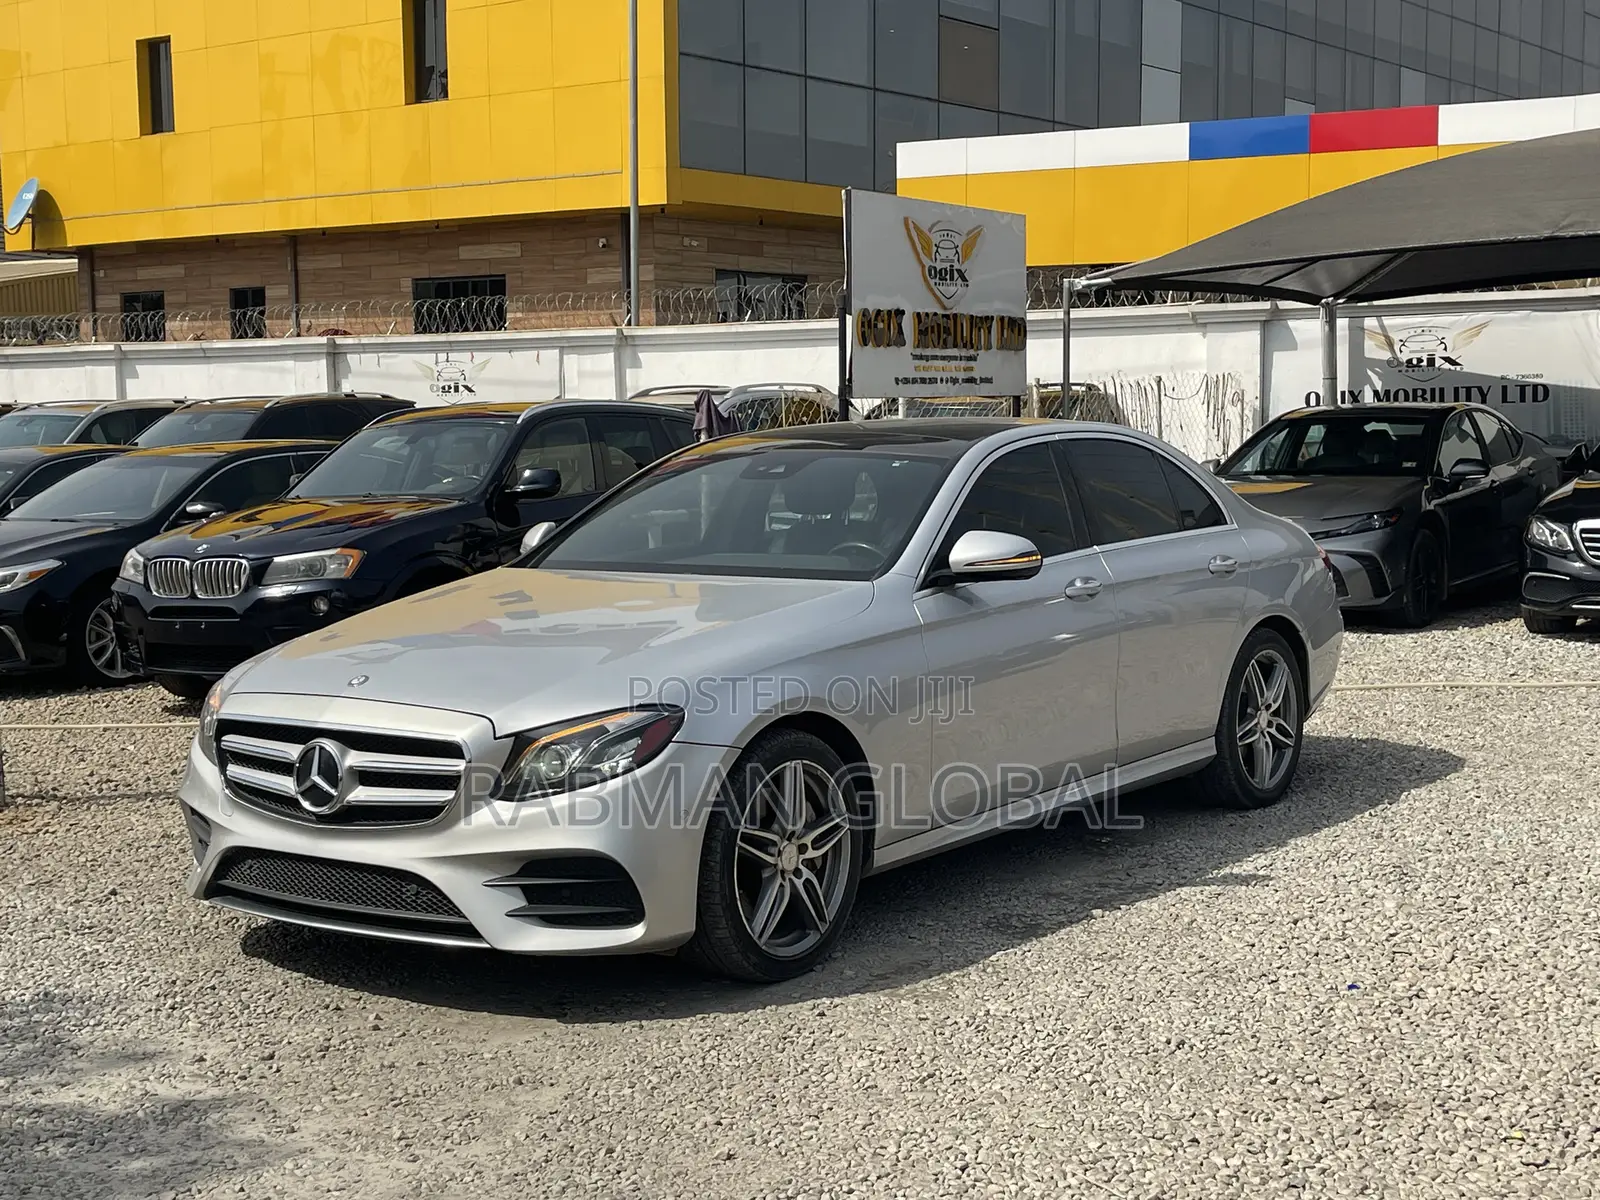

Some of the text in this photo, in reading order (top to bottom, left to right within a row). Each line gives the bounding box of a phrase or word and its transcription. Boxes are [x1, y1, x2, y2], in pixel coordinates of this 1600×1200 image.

[928, 264, 969, 282] Ogix
[857, 308, 1027, 351] OGIX MOBILITY LTD
[1304, 383, 1550, 408] OIX MOBILITY LTD
